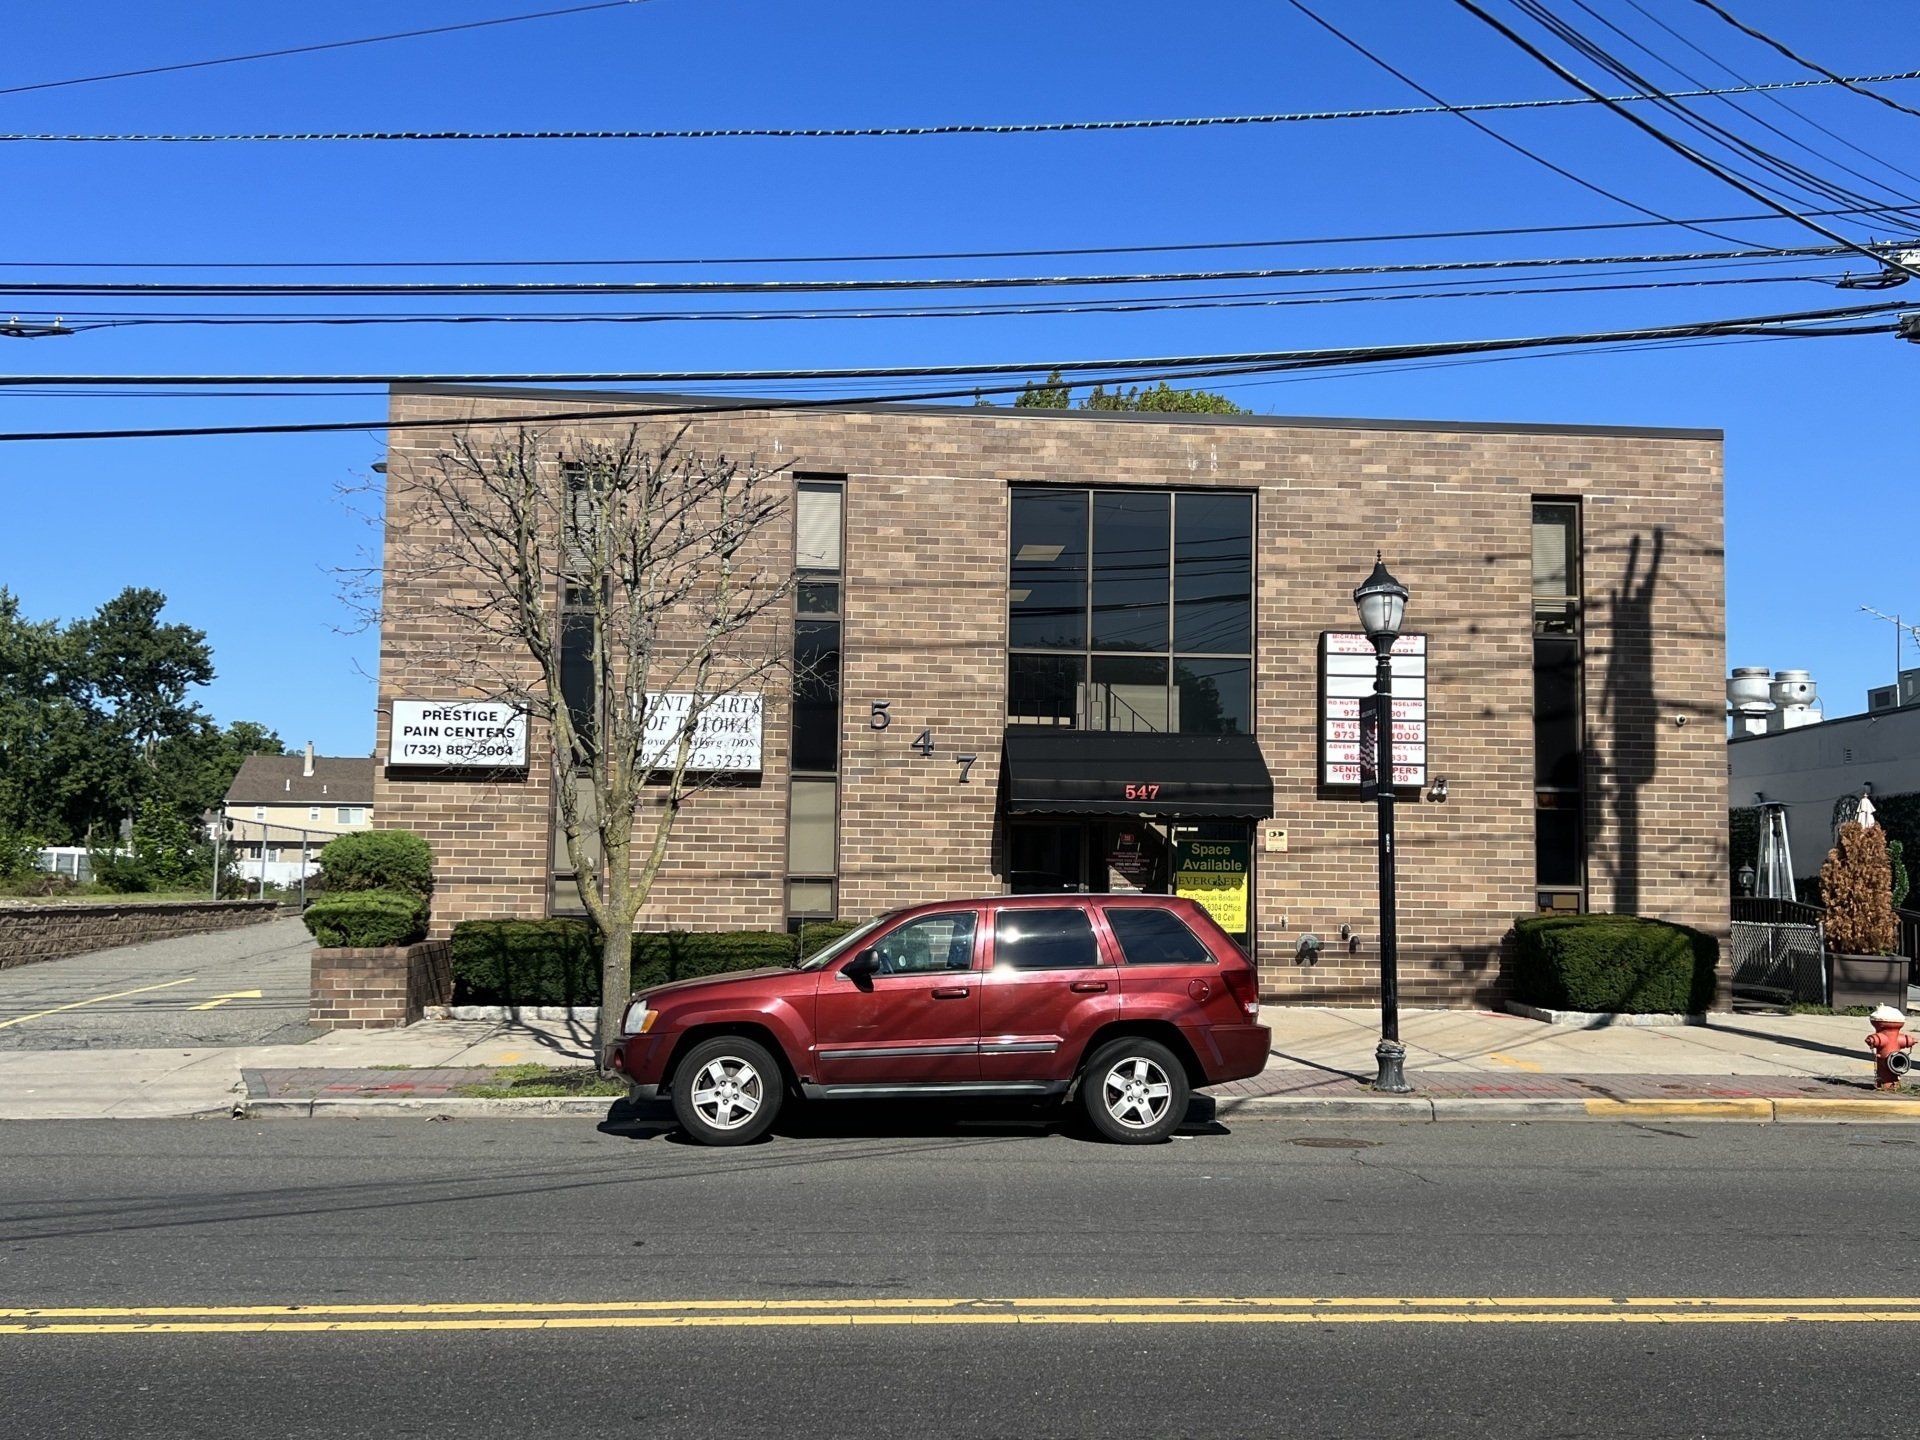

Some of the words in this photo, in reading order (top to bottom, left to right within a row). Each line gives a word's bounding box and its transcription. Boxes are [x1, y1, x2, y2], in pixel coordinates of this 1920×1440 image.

[715, 697, 760, 713] ARTS
[422, 710, 498, 721] PRESTIGE
[646, 715, 670, 731] OF
[676, 716, 749, 733] TTOWA
[403, 726, 439, 737] PAIN
[444, 726, 515, 738] CENTERS
[870, 701, 891, 730] 5
[911, 728, 935, 757] 4
[956, 755, 978, 784] 7
[404, 743, 441, 757] (732)
[446, 744, 514, 756] 887-2004
[1125, 784, 1160, 800] 547
[1191, 843, 1231, 857] Space
[1182, 859, 1242, 871] Available
[1223, 903, 1242, 912] Office
[1223, 912, 1235, 921] Cell
